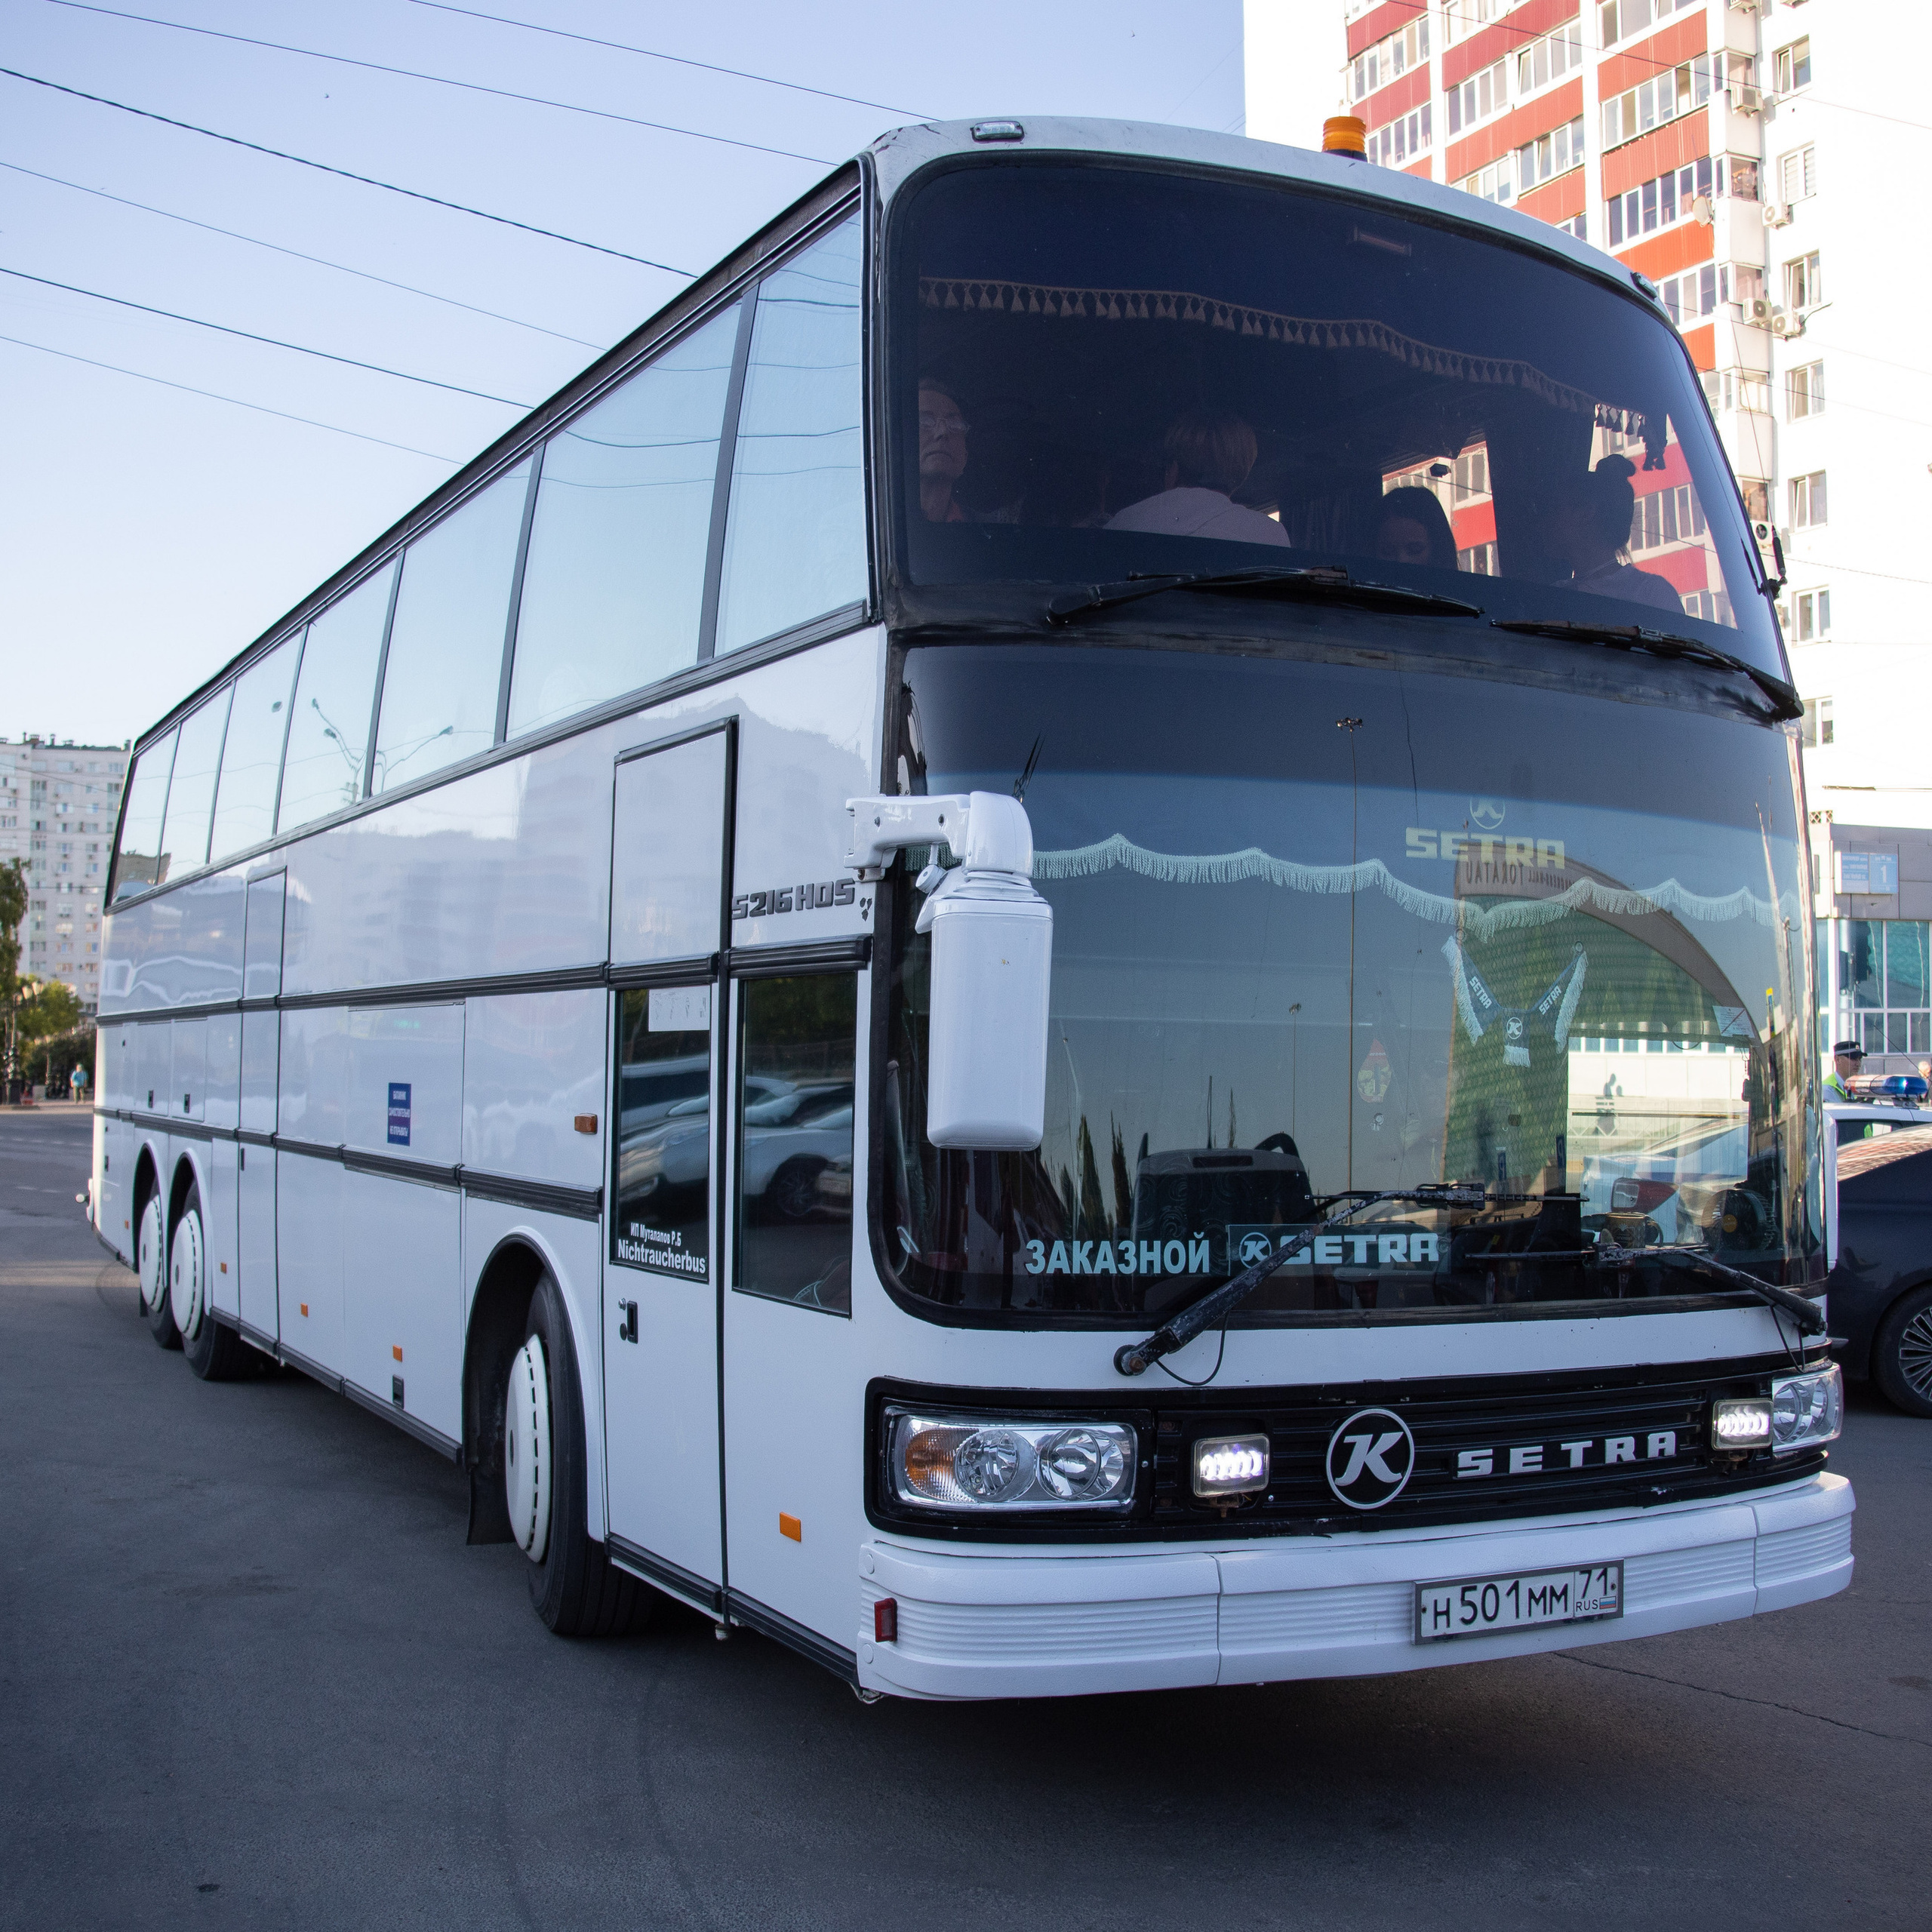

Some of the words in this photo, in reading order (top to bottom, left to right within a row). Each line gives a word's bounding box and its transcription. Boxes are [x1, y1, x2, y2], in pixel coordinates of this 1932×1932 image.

[1405, 827, 1565, 869] SETRA
[1880, 865, 1887, 883] 1
[1469, 976, 1492, 1009] SETRA
[1539, 985, 1561, 1015] SETRA
[630, 1222, 639, 1238] ИП
[618, 1238, 706, 1274] Nichtraucherbus
[1025, 1232, 1210, 1275] ЗАКАЗНОЙ
[1456, 1430, 1676, 1478] SETRA
[1579, 1567, 1608, 1600] 71
[1576, 1598, 1598, 1613] RUS
